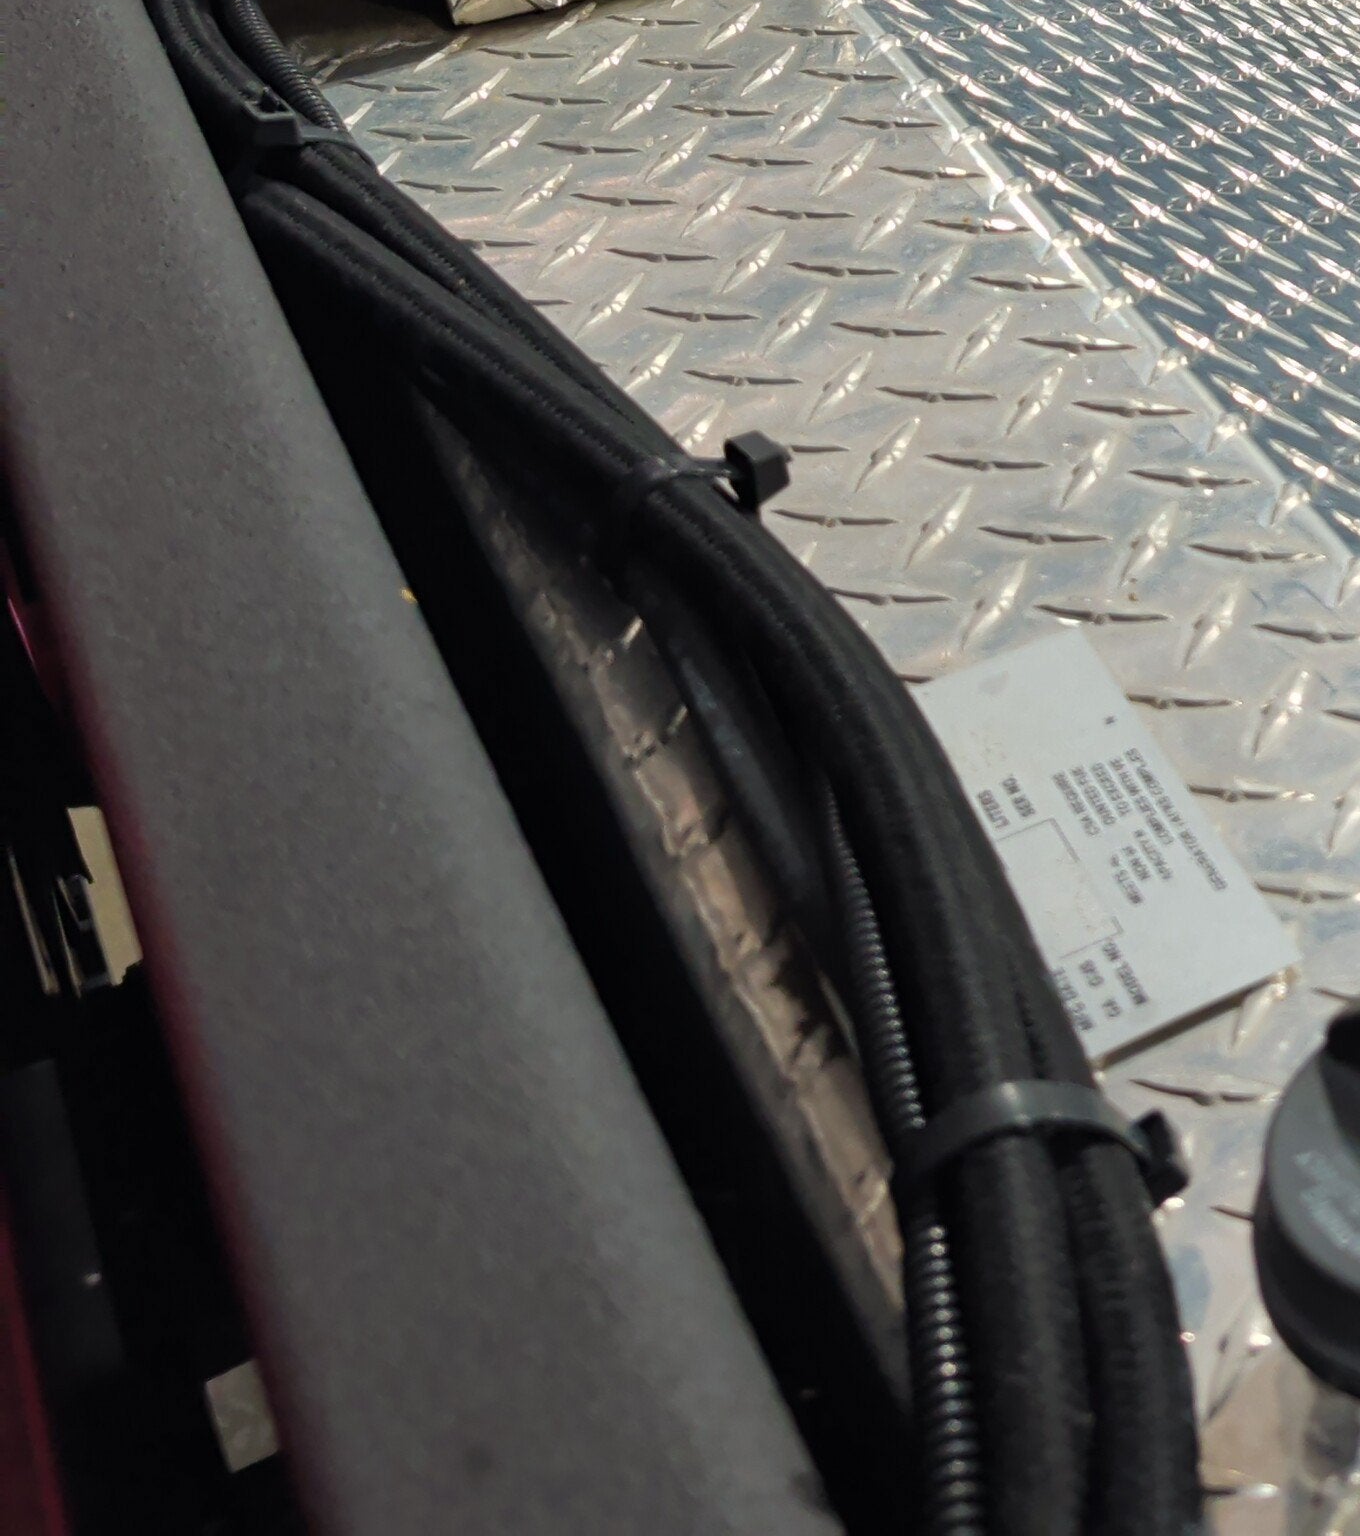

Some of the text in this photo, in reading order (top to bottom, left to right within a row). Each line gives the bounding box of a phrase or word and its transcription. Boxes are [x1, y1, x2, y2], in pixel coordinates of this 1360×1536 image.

[976, 788, 1010, 829] LITERS
[1012, 793, 1036, 818] SER
[1113, 961, 1149, 1006] MODEL
